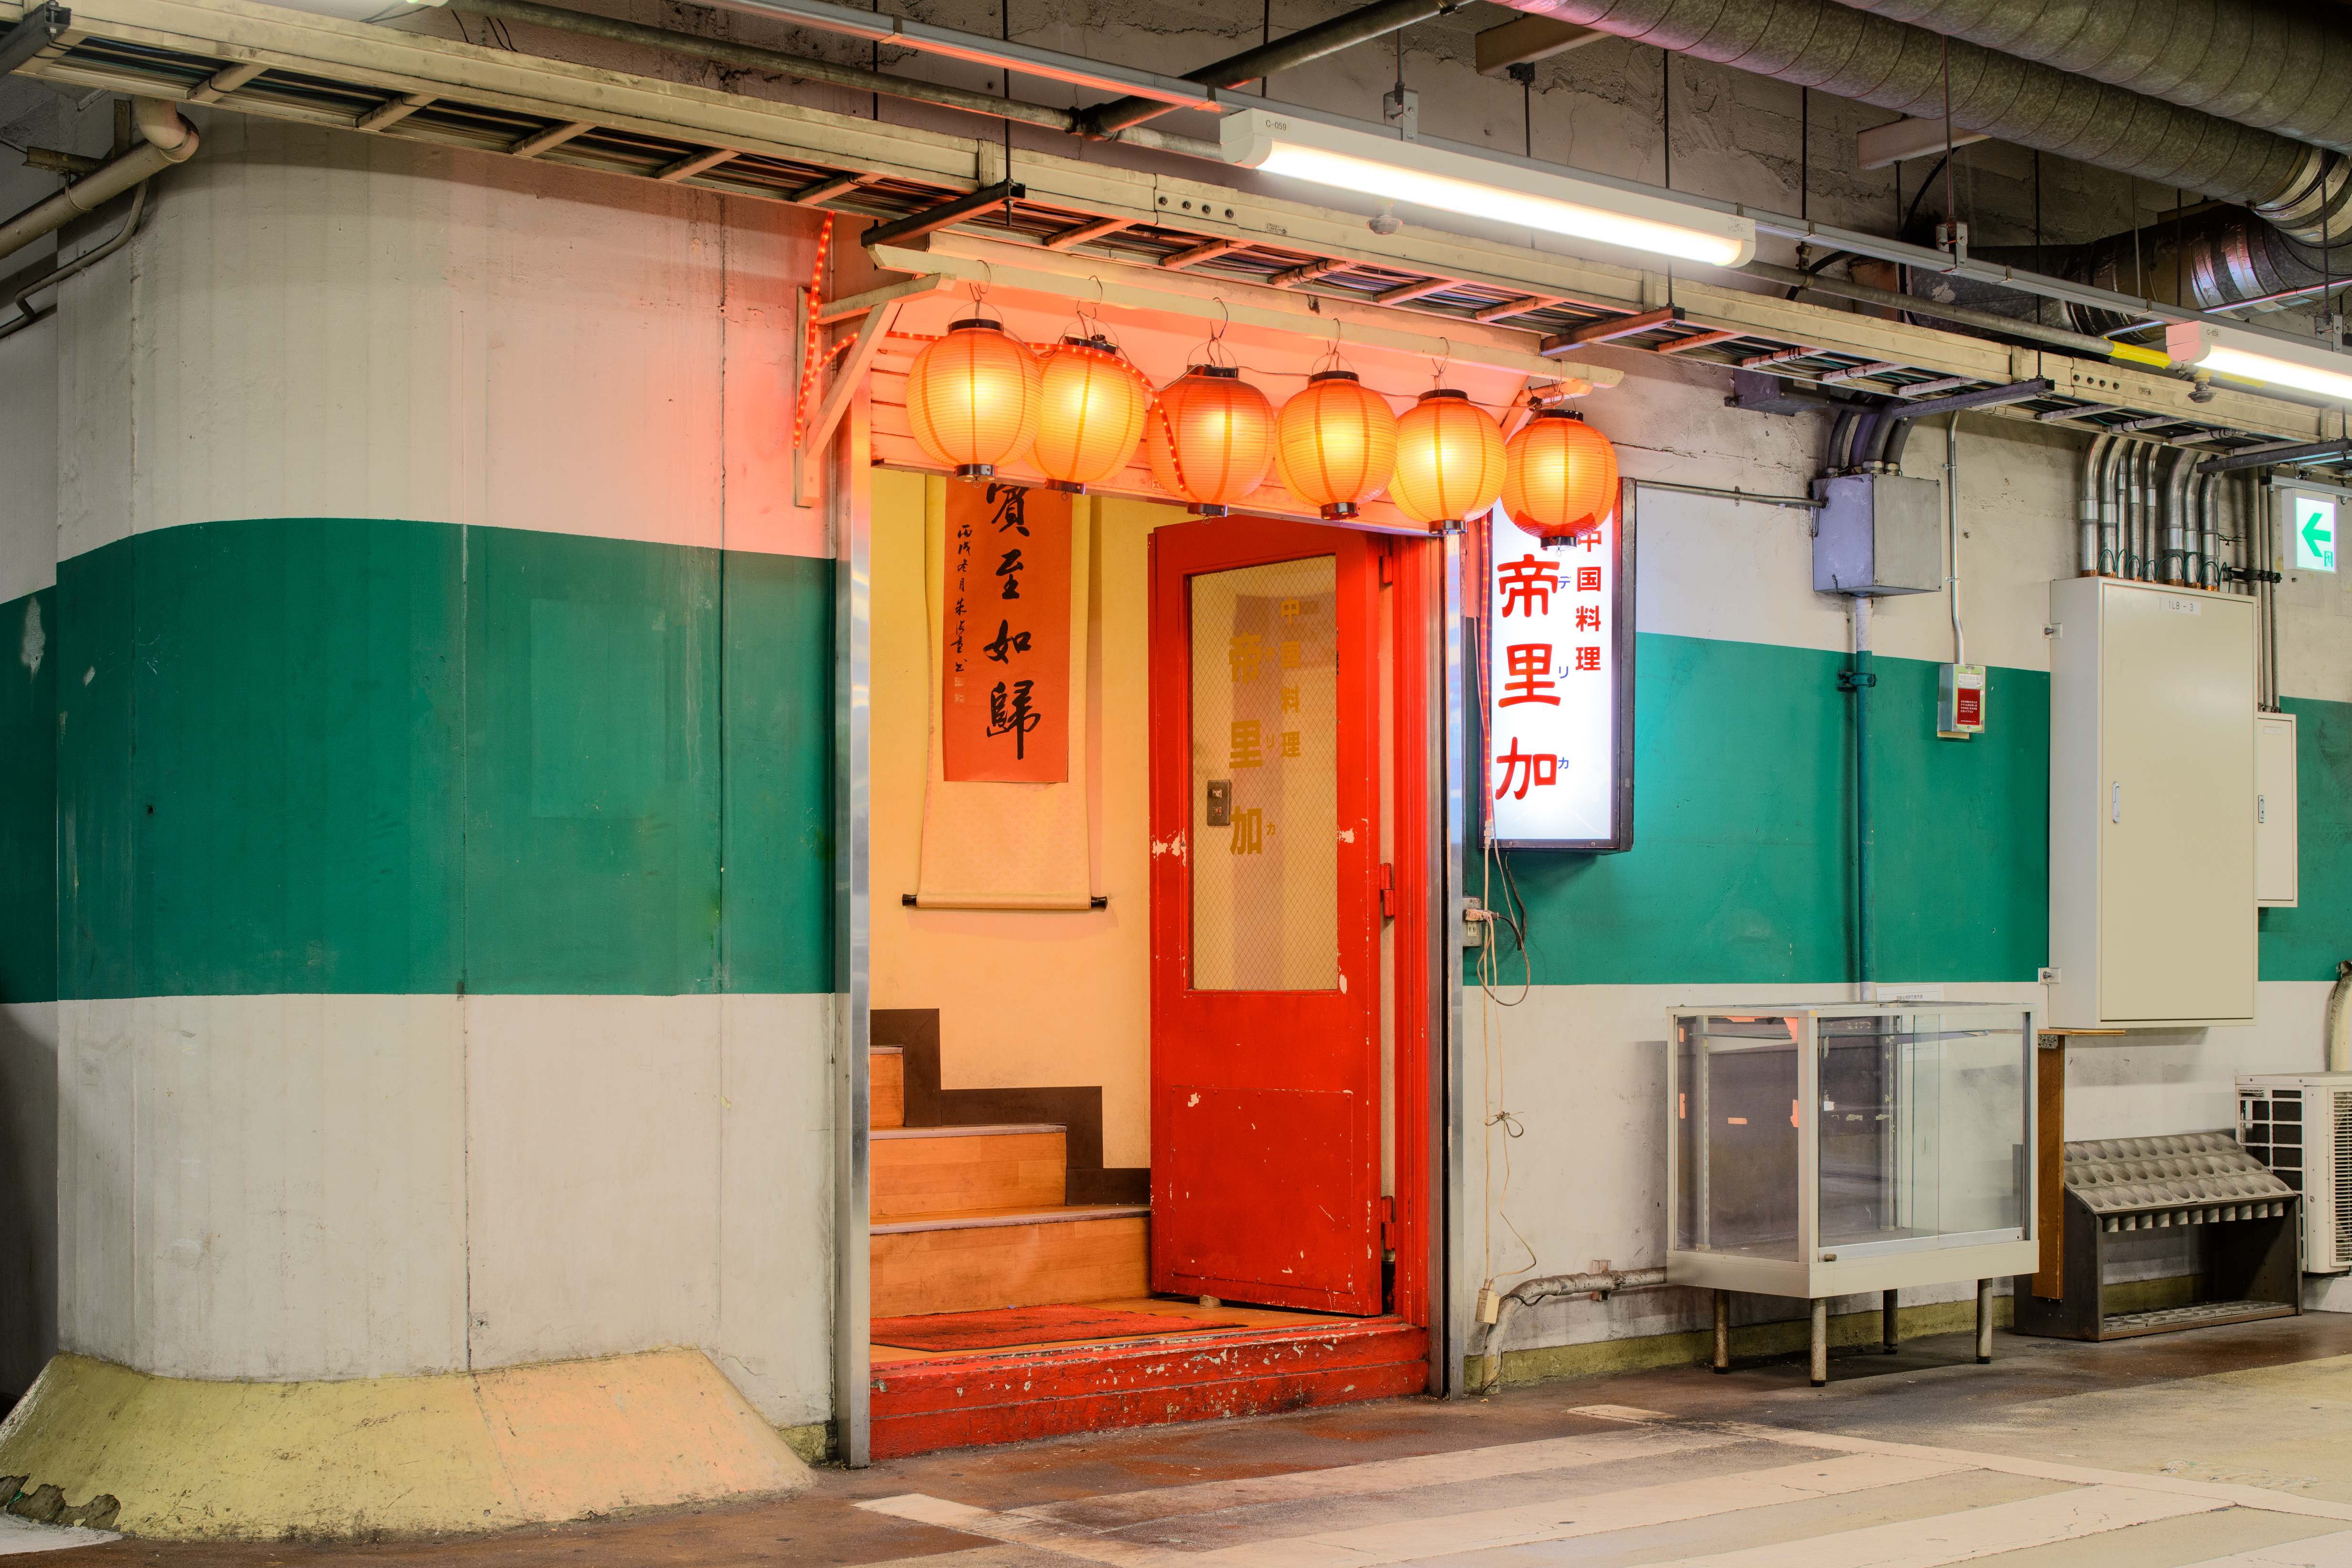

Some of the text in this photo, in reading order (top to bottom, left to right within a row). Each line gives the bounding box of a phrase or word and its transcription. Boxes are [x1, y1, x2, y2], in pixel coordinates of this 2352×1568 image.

[1266, 119, 1287, 131] C-059
[2206, 329, 2219, 337] C-058
[1281, 596, 1301, 758] 中国料理
[1495, 554, 1561, 800] 帝里加
[1558, 576, 1571, 769] デリカ
[1575, 531, 1602, 671] 中国料理
[1229, 632, 1263, 856] 帝里加
